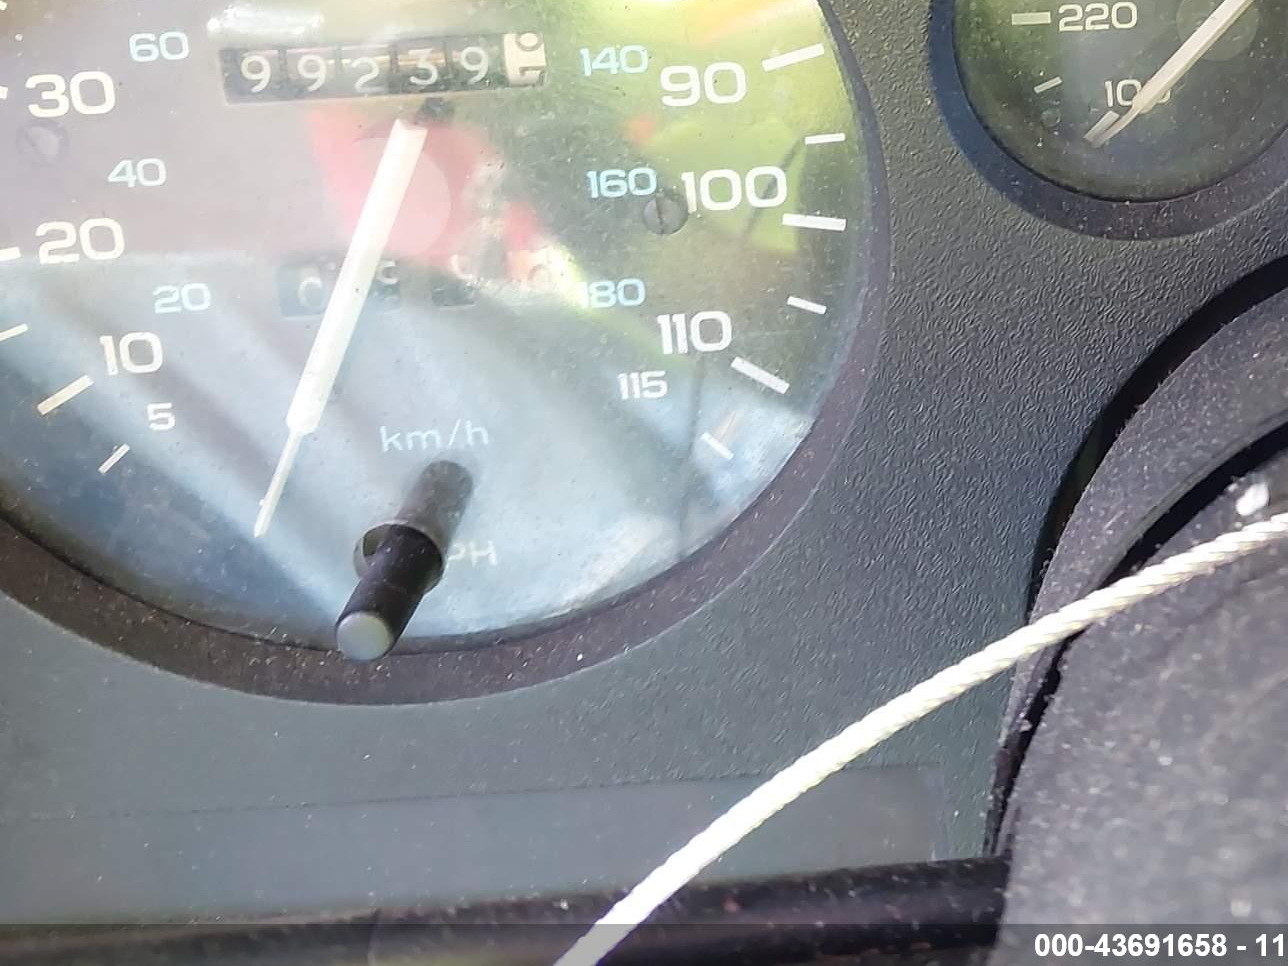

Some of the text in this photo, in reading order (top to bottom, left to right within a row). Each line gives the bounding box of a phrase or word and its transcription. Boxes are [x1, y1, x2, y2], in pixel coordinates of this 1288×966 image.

[1058, 1, 1139, 32] 220
[128, 32, 190, 62] 60
[579, 45, 648, 76] 140
[25, 71, 116, 118] 30
[660, 62, 747, 107] 90
[107, 157, 166, 188] 40
[586, 167, 657, 199] 160
[681, 166, 787, 214] 100
[35, 218, 125, 264] 20
[152, 283, 211, 314] 20
[657, 310, 732, 355] 110
[100, 332, 163, 376] 10
[617, 370, 668, 400] 115
[147, 402, 175, 431] 5
[380, 419, 489, 452] km/h
